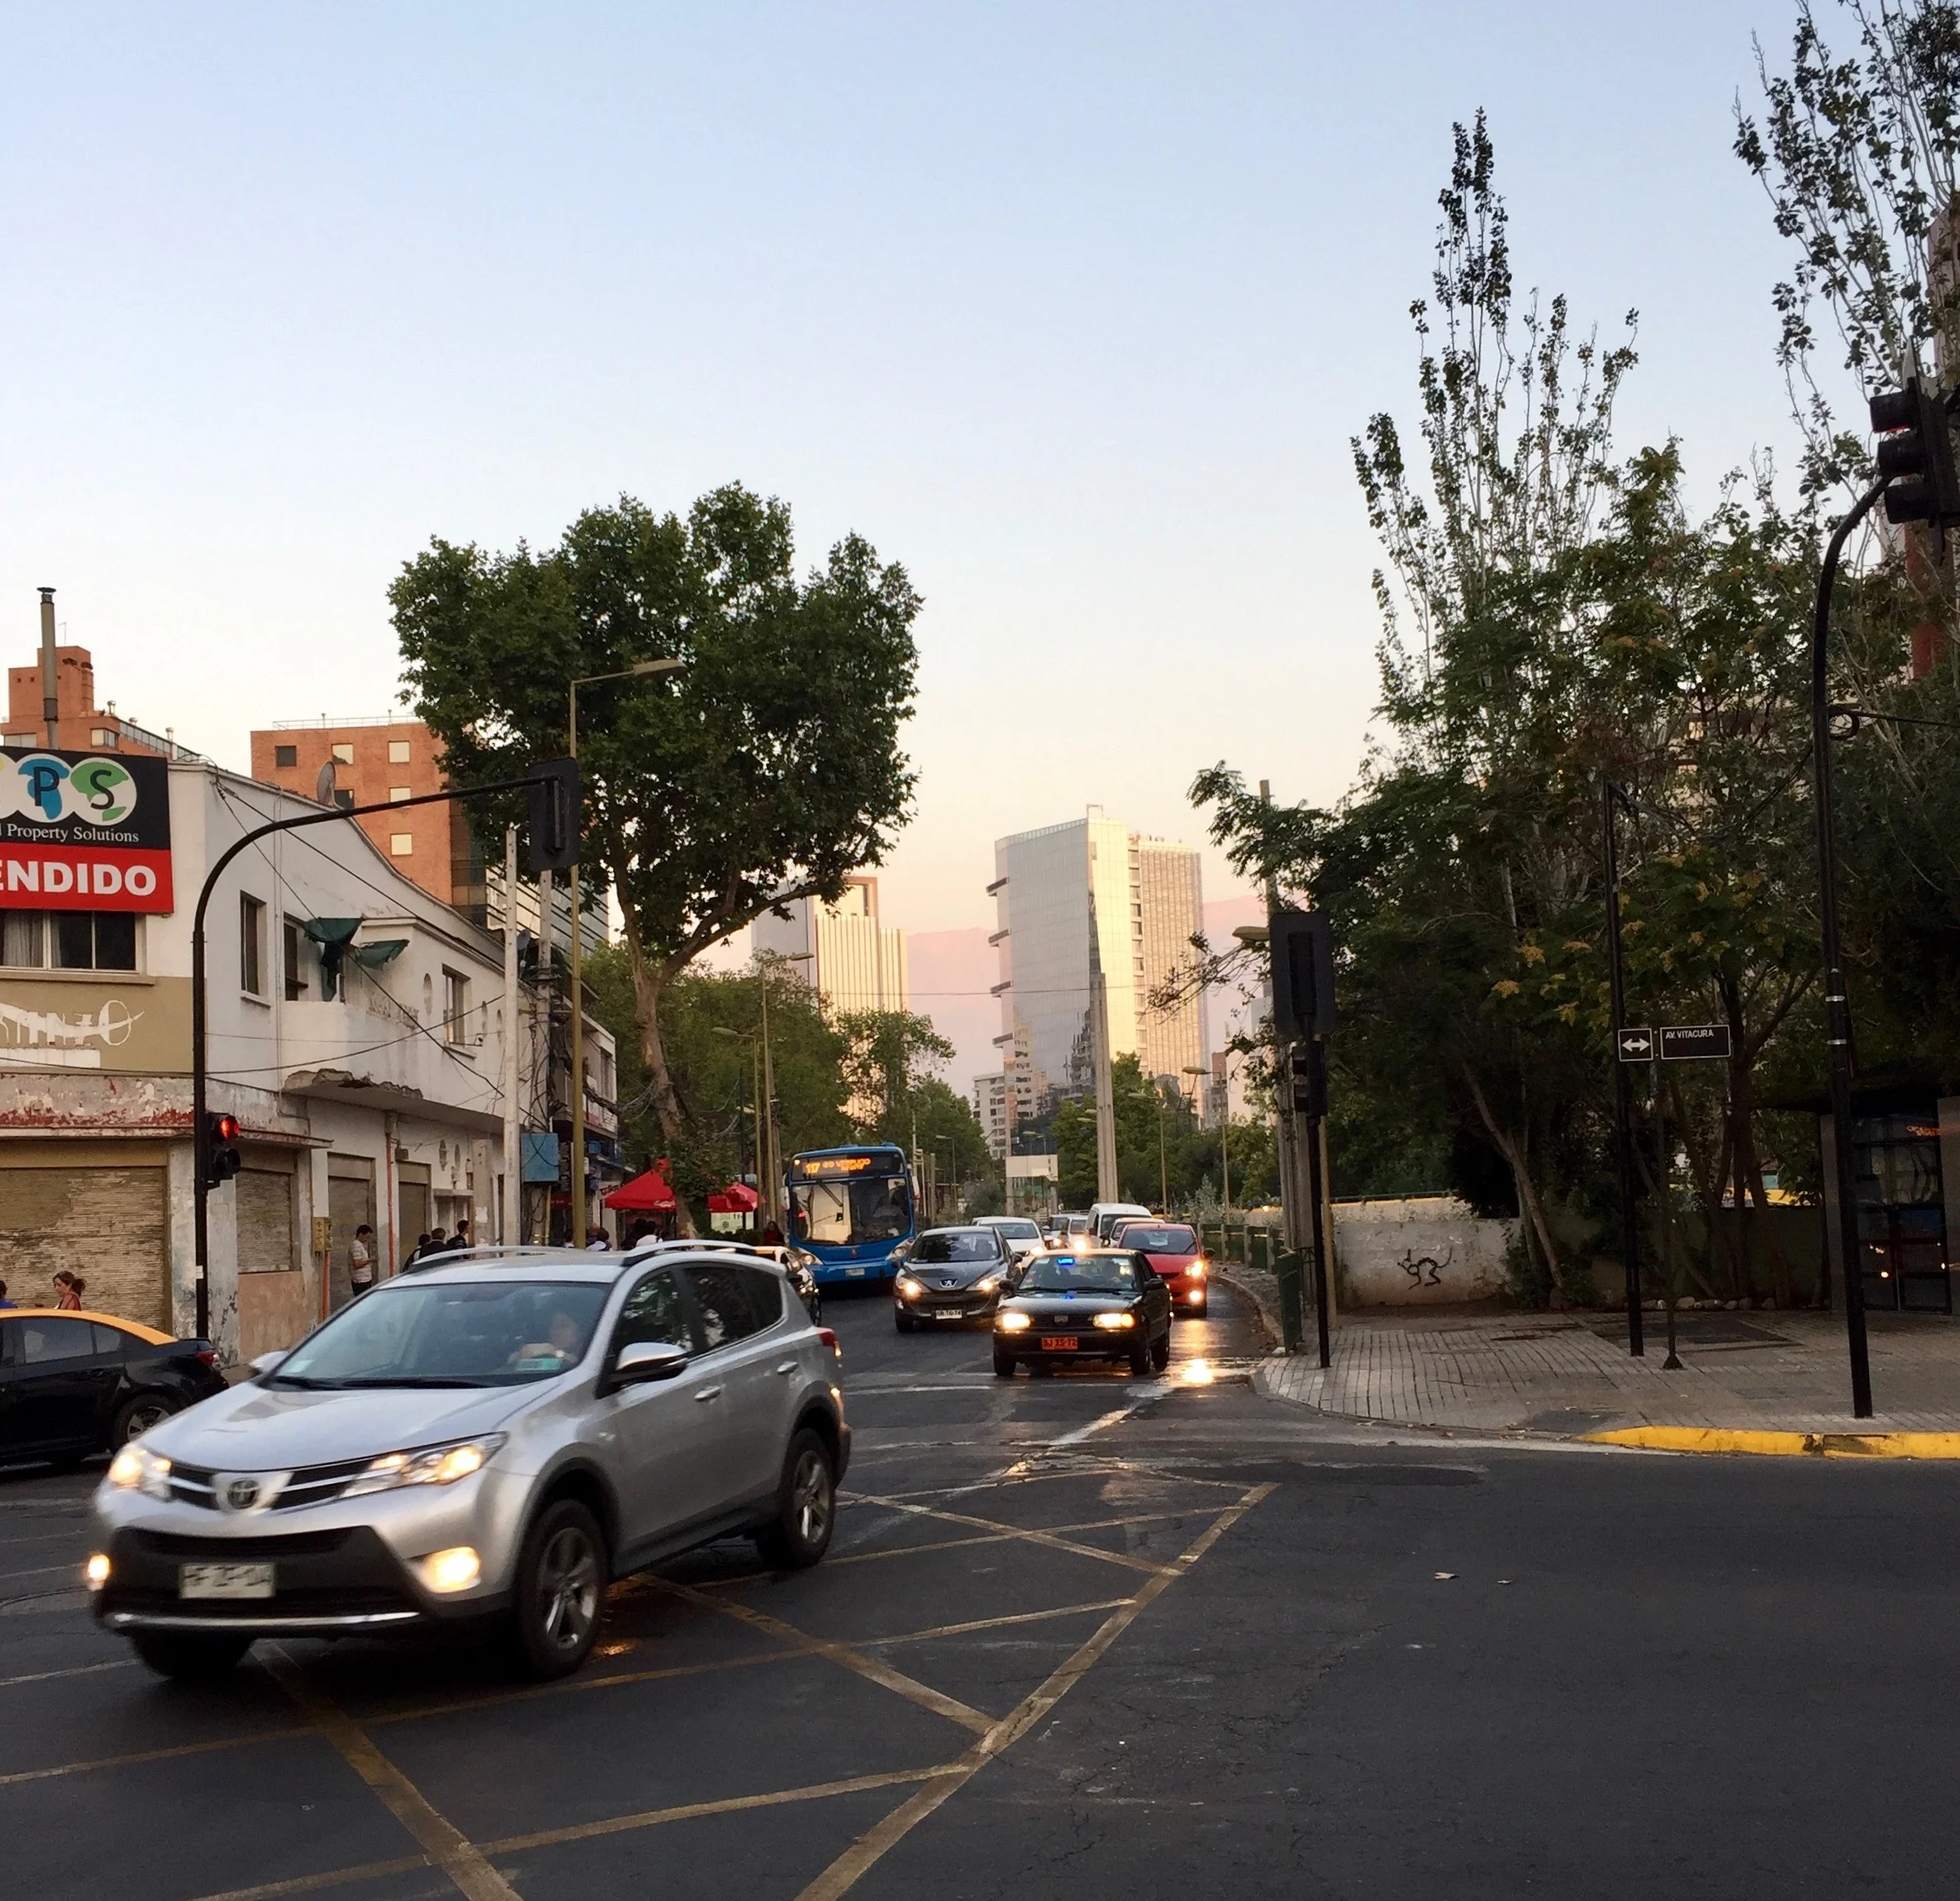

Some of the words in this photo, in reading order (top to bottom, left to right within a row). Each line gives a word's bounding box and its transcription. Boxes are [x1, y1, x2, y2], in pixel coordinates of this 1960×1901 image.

[7, 824, 68, 843] Property
[74, 827, 140, 843] Solutions
[0, 860, 156, 896] NDIDO
[1677, 1029, 1714, 1038] VITACURA
